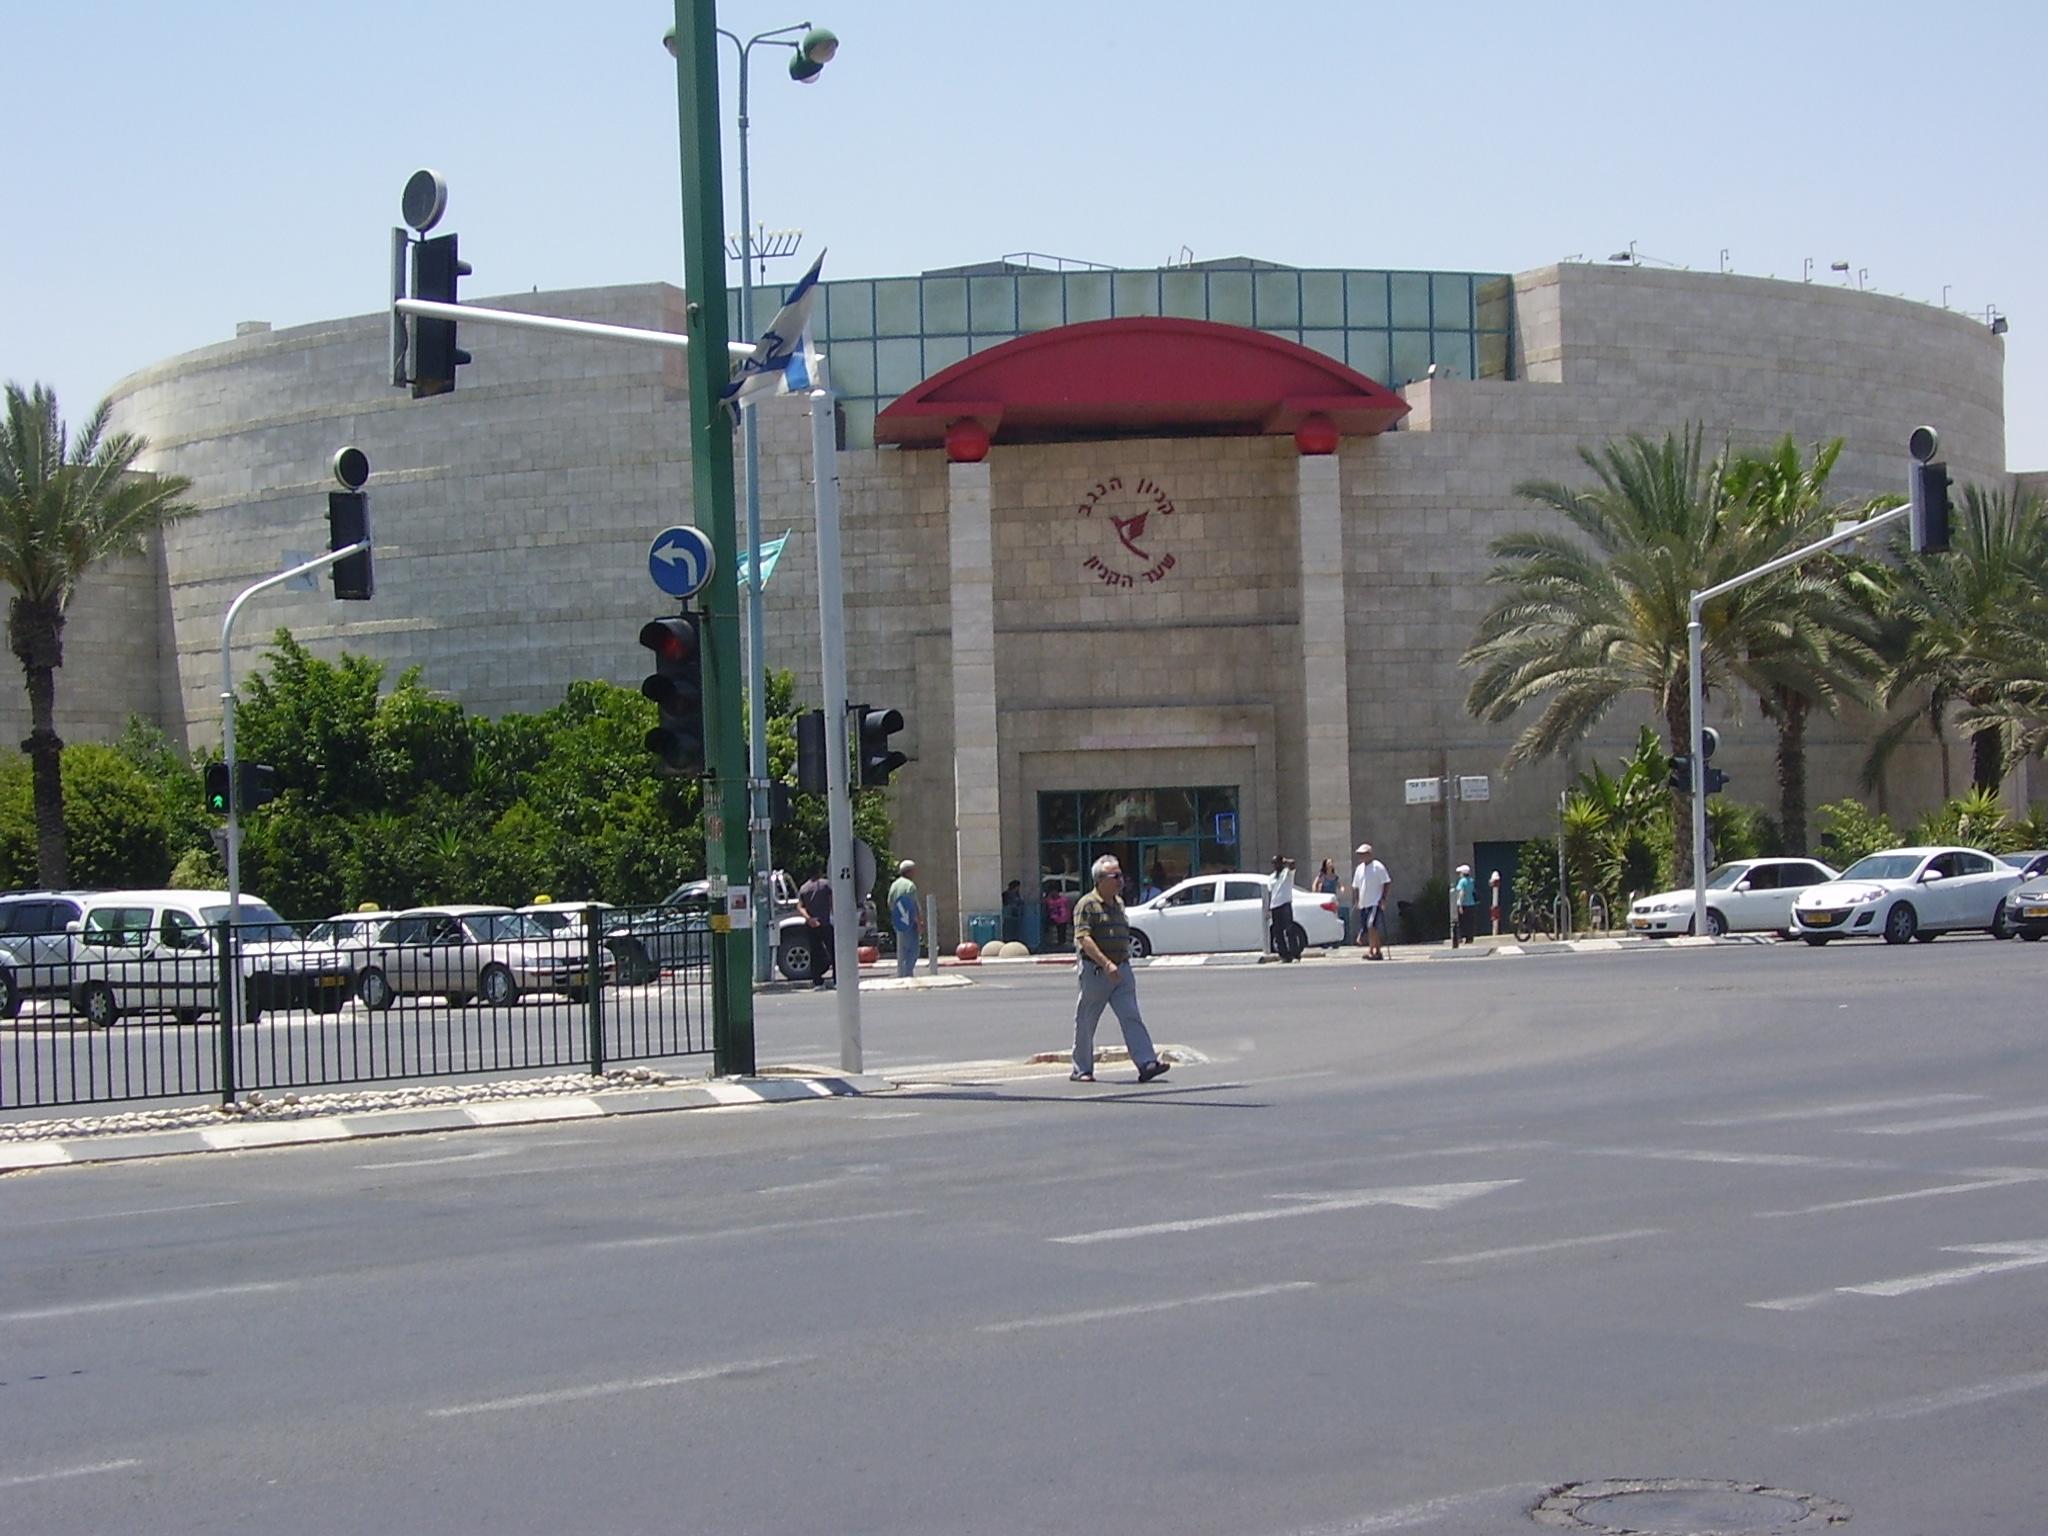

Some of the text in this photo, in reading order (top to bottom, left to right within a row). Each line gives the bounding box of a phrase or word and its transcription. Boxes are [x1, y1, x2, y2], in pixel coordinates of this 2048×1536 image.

[1078, 477, 1175, 517] קניון הנגב
[1083, 553, 1176, 588] שער הקניון
